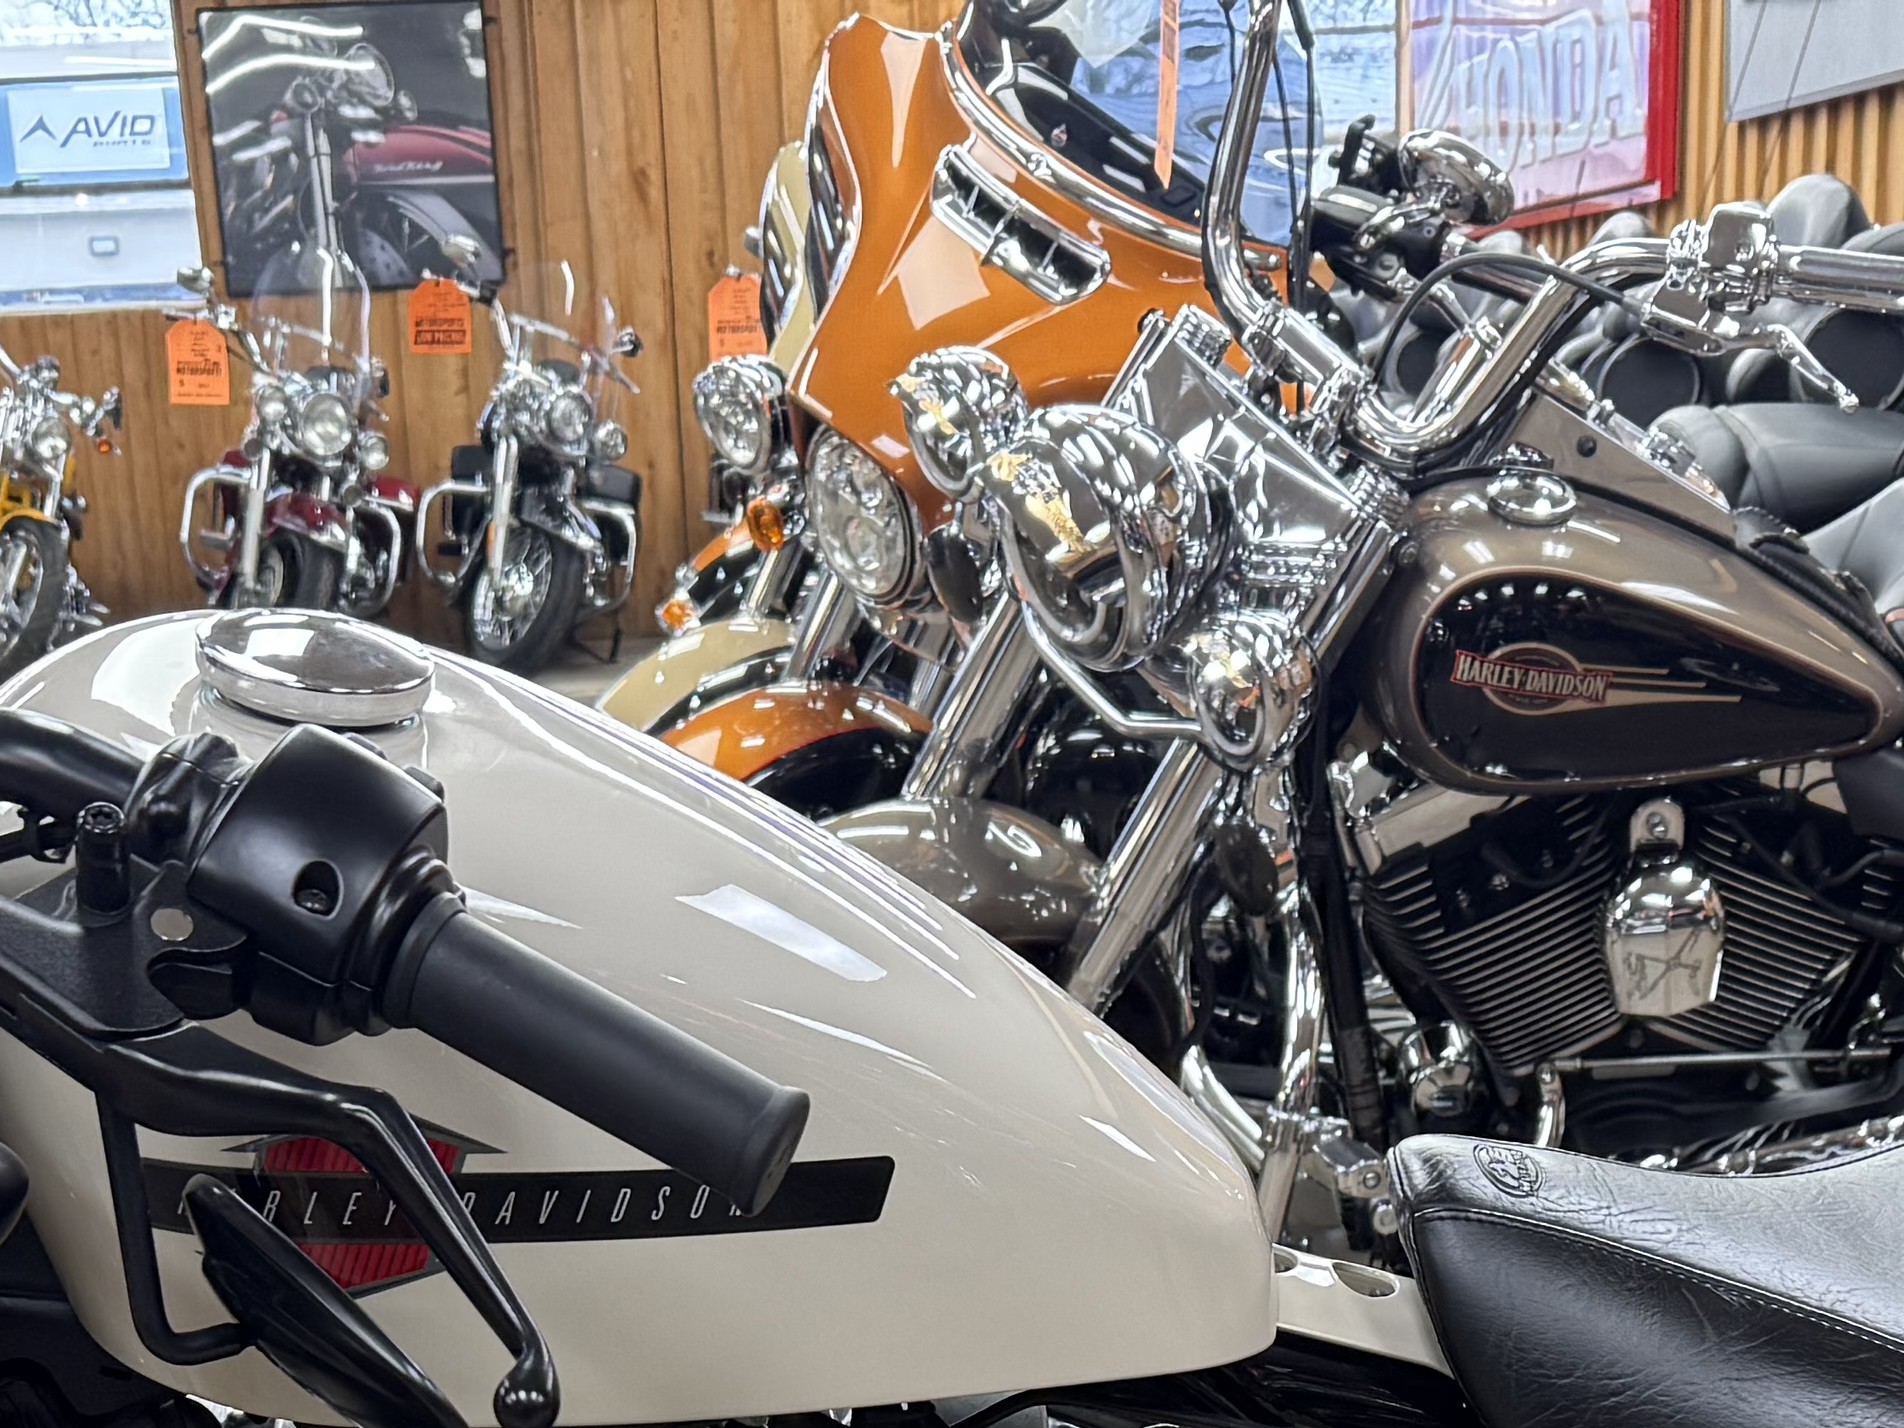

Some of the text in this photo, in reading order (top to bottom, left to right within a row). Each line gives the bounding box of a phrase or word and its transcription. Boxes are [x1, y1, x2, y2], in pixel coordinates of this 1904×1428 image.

[1450, 2, 1646, 172] HONDA
[60, 110, 155, 148] AVID
[1457, 655, 1609, 701] HARLEY-DAVIDSON
